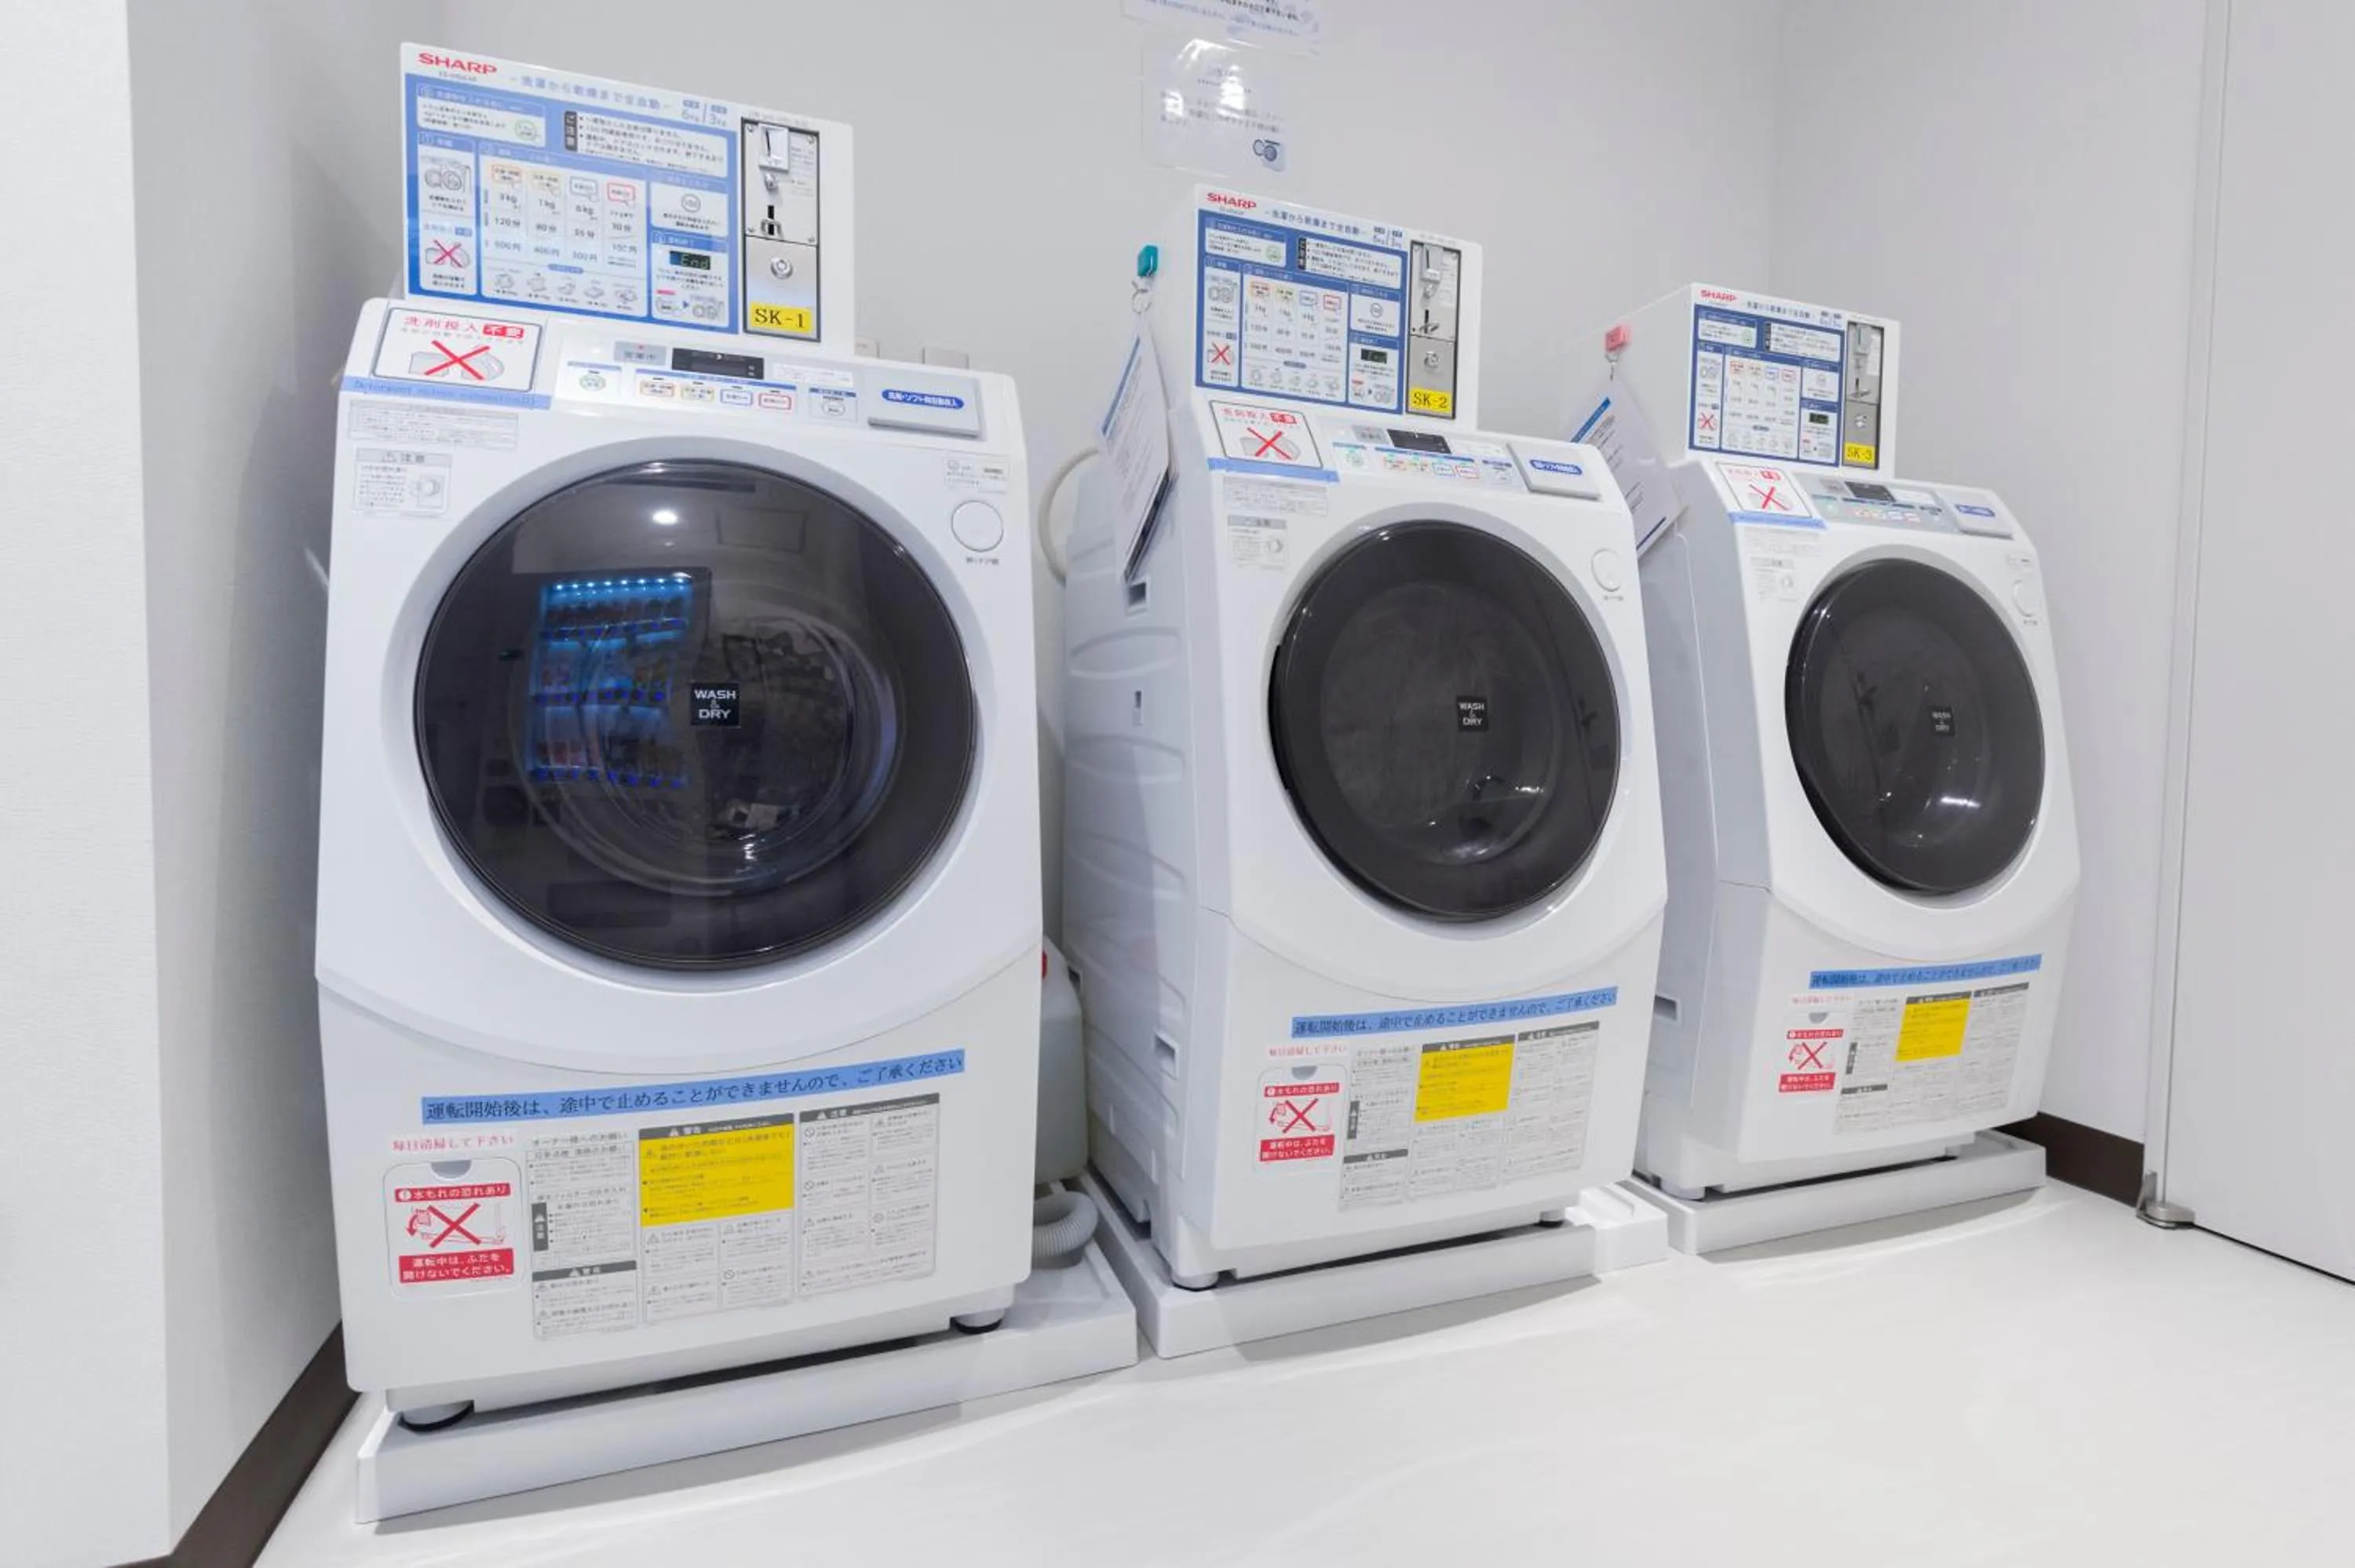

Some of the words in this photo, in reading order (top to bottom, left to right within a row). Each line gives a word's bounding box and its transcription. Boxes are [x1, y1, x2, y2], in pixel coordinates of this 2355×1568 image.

[418, 52, 498, 75] SHARP
[1207, 191, 1257, 210] SHARP
[1700, 290, 1736, 302] SHARP
[754, 308, 805, 329] SK-1
[1413, 392, 1448, 410] SK-2
[1847, 447, 1873, 461] SK-3
[694, 689, 736, 699] WASH
[699, 709, 731, 719] DRY
